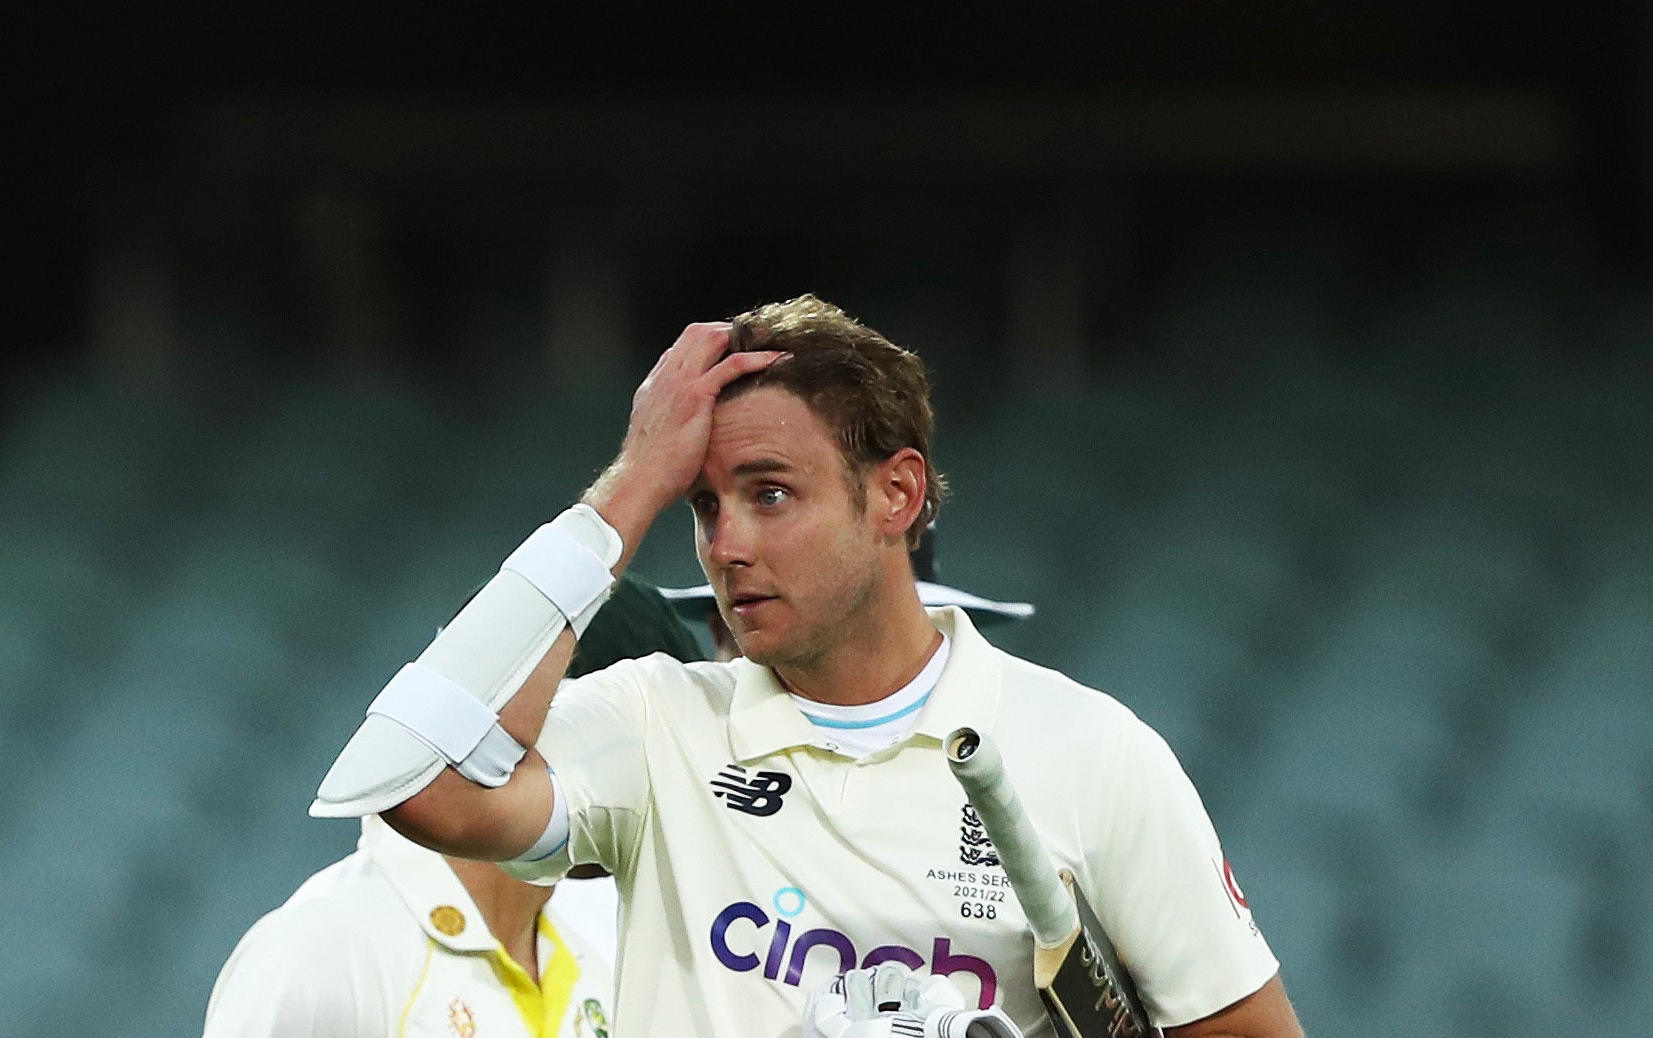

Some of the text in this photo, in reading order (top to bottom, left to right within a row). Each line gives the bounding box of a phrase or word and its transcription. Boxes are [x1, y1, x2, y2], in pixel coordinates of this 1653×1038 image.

[926, 869, 1012, 888] ASHES SER
[953, 885, 1006, 903] 2021/22
[960, 901, 997, 920] 638
